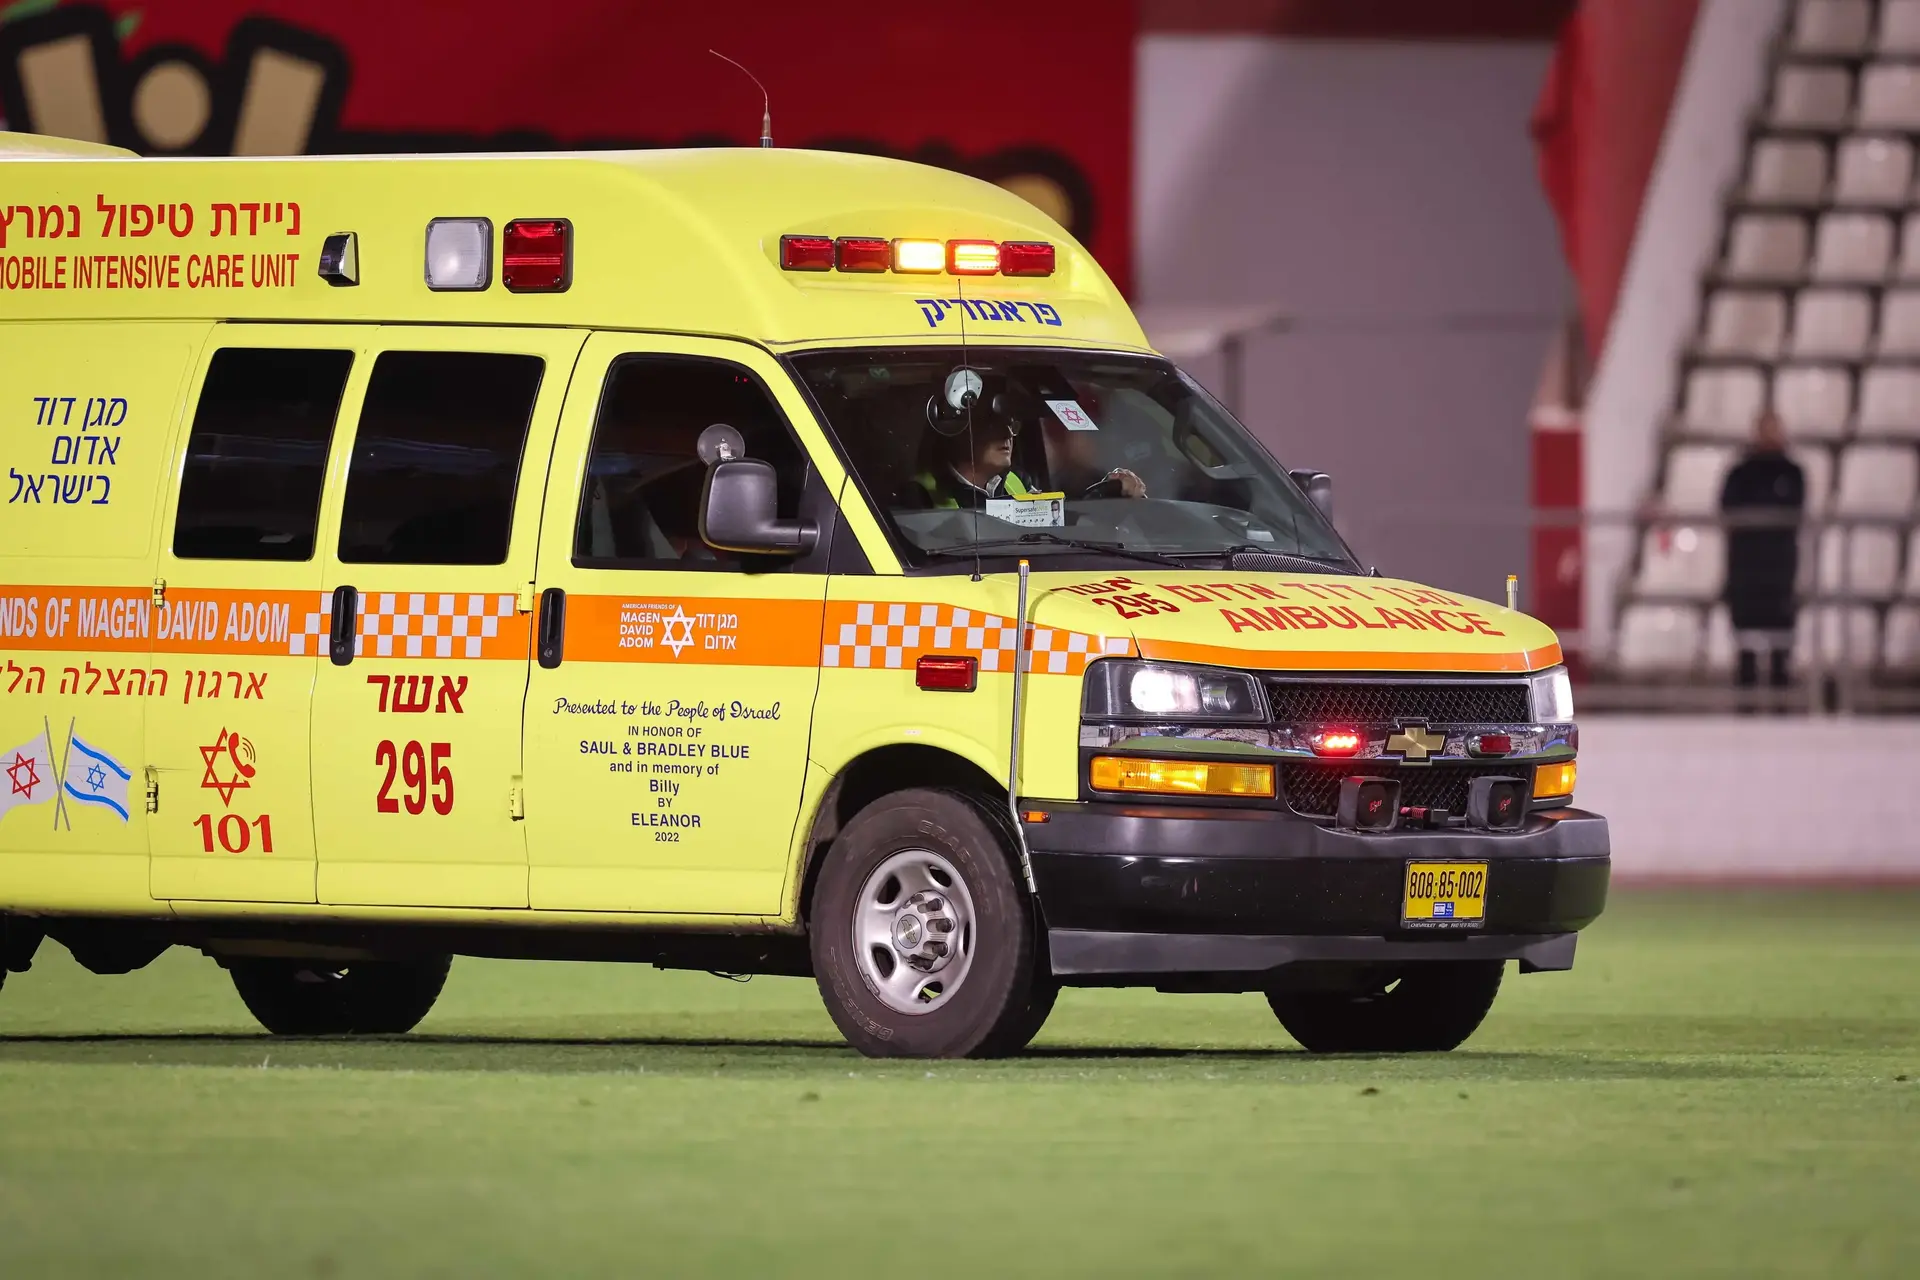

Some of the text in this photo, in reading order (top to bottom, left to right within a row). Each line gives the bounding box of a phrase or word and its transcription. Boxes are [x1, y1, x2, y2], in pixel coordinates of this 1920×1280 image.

[97, 194, 194, 238] טיפול
[210, 202, 301, 236] ניידת
[0, 253, 299, 289] OBILE INTENSIVE CARE UNIT
[915, 300, 1062, 327] פראמדיק
[33, 397, 127, 431] מגן דוד
[51, 435, 121, 466] אדום
[9, 468, 111, 505] בישראל
[1092, 593, 1180, 619] 295
[1155, 583, 1464, 607] מגן דוד אדום
[45, 597, 72, 637] OF
[77, 598, 150, 639] MAGEN
[157, 600, 218, 641] DAVID
[224, 602, 290, 643] ADOM
[620, 612, 660, 623] MAGEN
[620, 624, 654, 635] DAVID
[696, 614, 738, 631] מגן דוד
[1219, 605, 1506, 636] AMBULANCE
[618, 637, 653, 648] ADOM
[704, 635, 736, 650] אדום
[59, 661, 169, 697] ההצלה
[183, 670, 269, 704] ארגון
[367, 674, 469, 714] אשר
[552, 698, 781, 723] Presented to the People of Israel
[628, 726, 702, 738] IN HONOR OF
[580, 741, 749, 759] SAUL & BRADLEY BLUE
[375, 739, 454, 816] 295
[609, 761, 719, 777] and in memory of
[649, 779, 680, 795] Billy
[658, 798, 672, 808] BY
[193, 813, 273, 853] 101
[631, 813, 701, 828] ELEANOR
[655, 832, 680, 842] 2022
